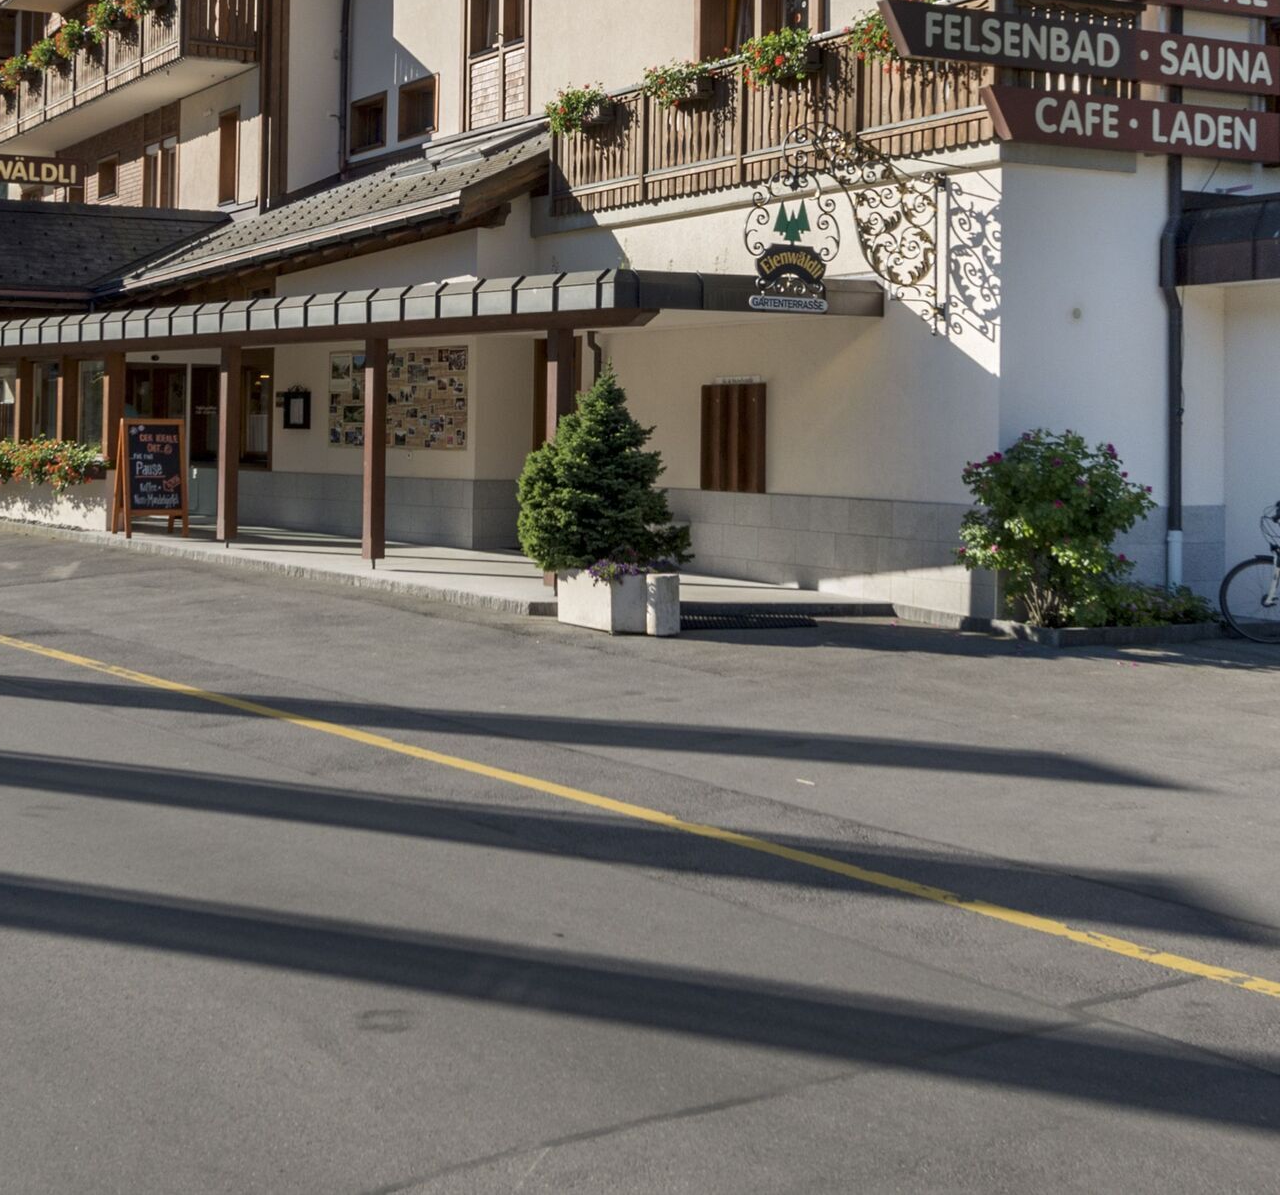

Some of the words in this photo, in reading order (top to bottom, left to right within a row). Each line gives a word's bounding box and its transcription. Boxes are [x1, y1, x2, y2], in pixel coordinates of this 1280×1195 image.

[924, 11, 1120, 68] FELSENBAD
[1160, 40, 1273, 86] SAUNA
[1035, 97, 1119, 139] CAFE
[1152, 108, 1257, 151] LADEN
[760, 251, 824, 279] Eienwäldli
[751, 297, 825, 310] GARTENTERRASSE
[135, 461, 163, 476] Pause
